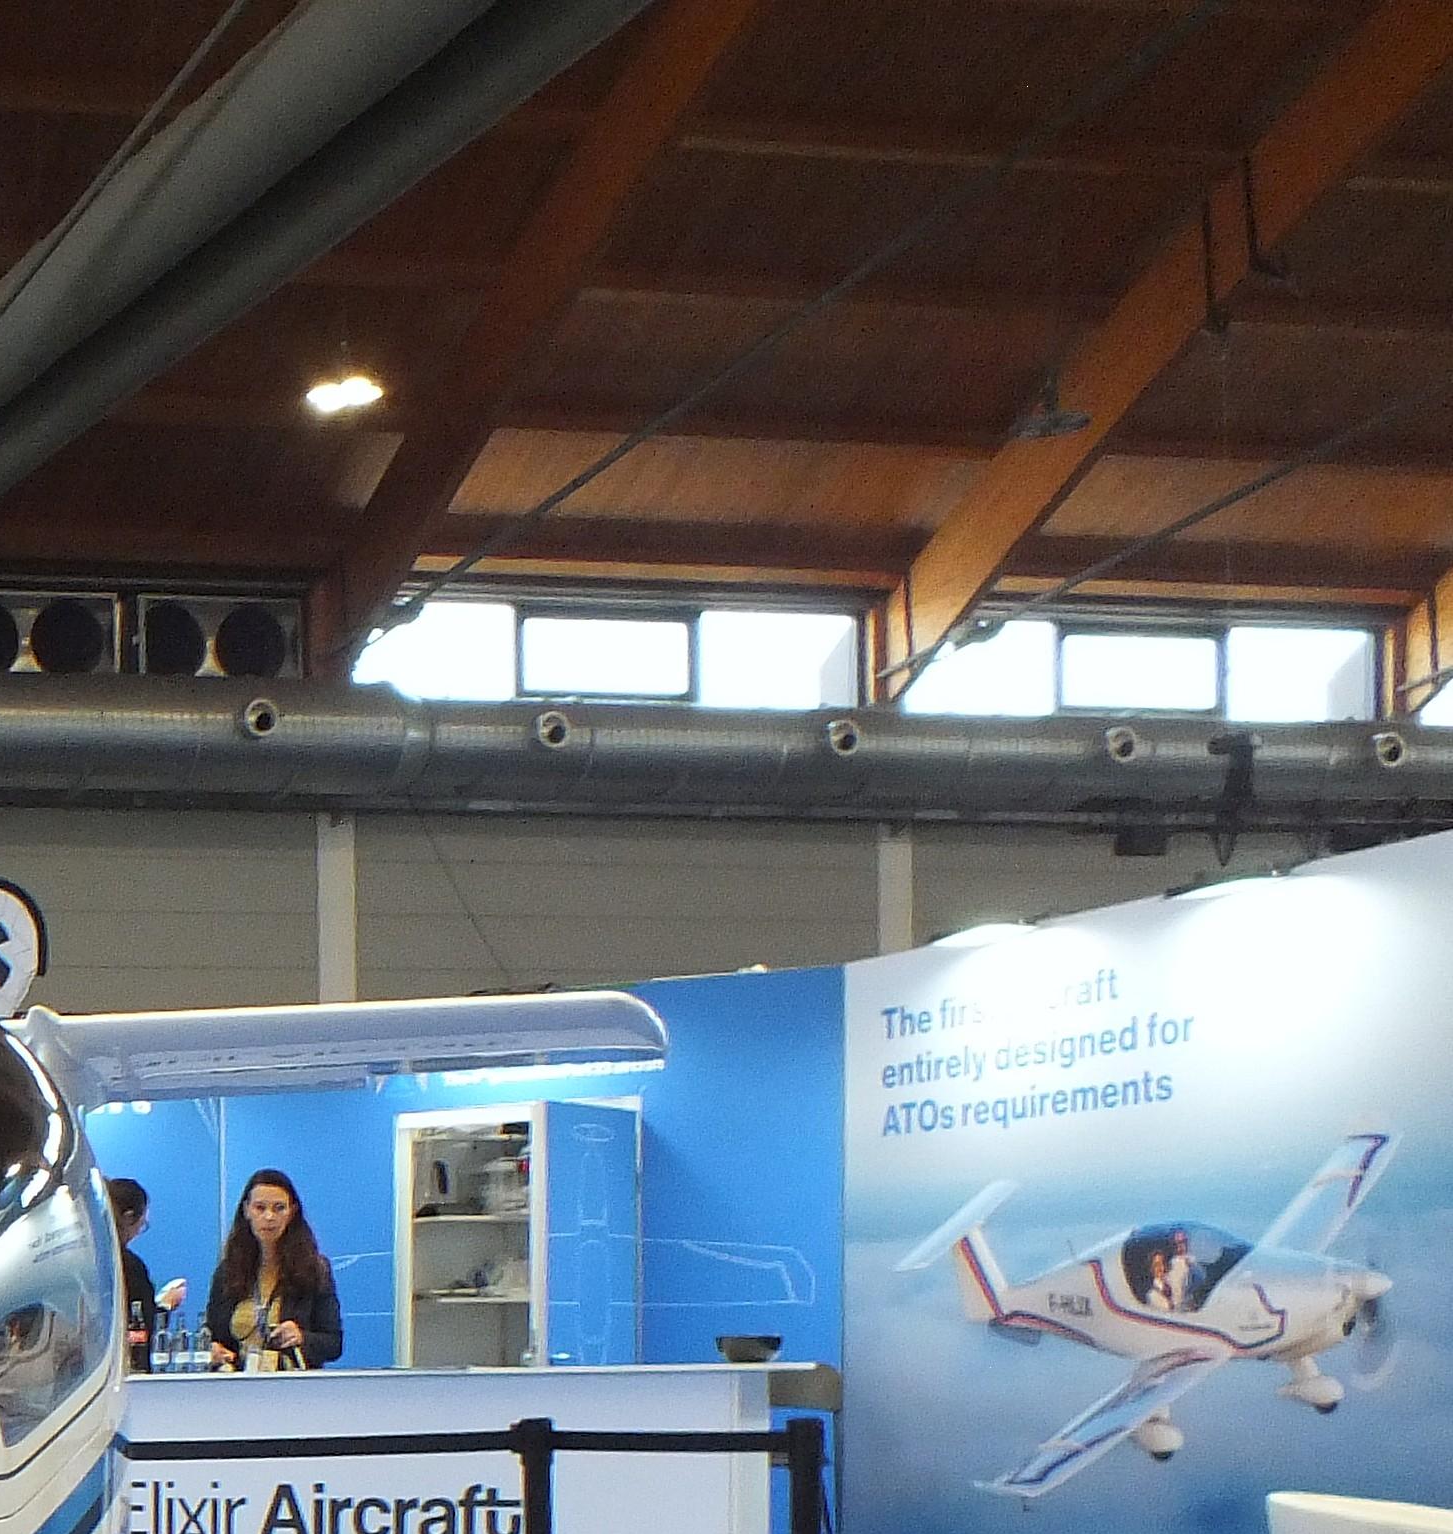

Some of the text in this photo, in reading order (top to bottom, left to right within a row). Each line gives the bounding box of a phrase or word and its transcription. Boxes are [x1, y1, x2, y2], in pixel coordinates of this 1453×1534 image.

[881, 1005, 932, 1040] The
[881, 1011, 1195, 1088] entirely designed for
[882, 1070, 1173, 1137] ATOs requirements
